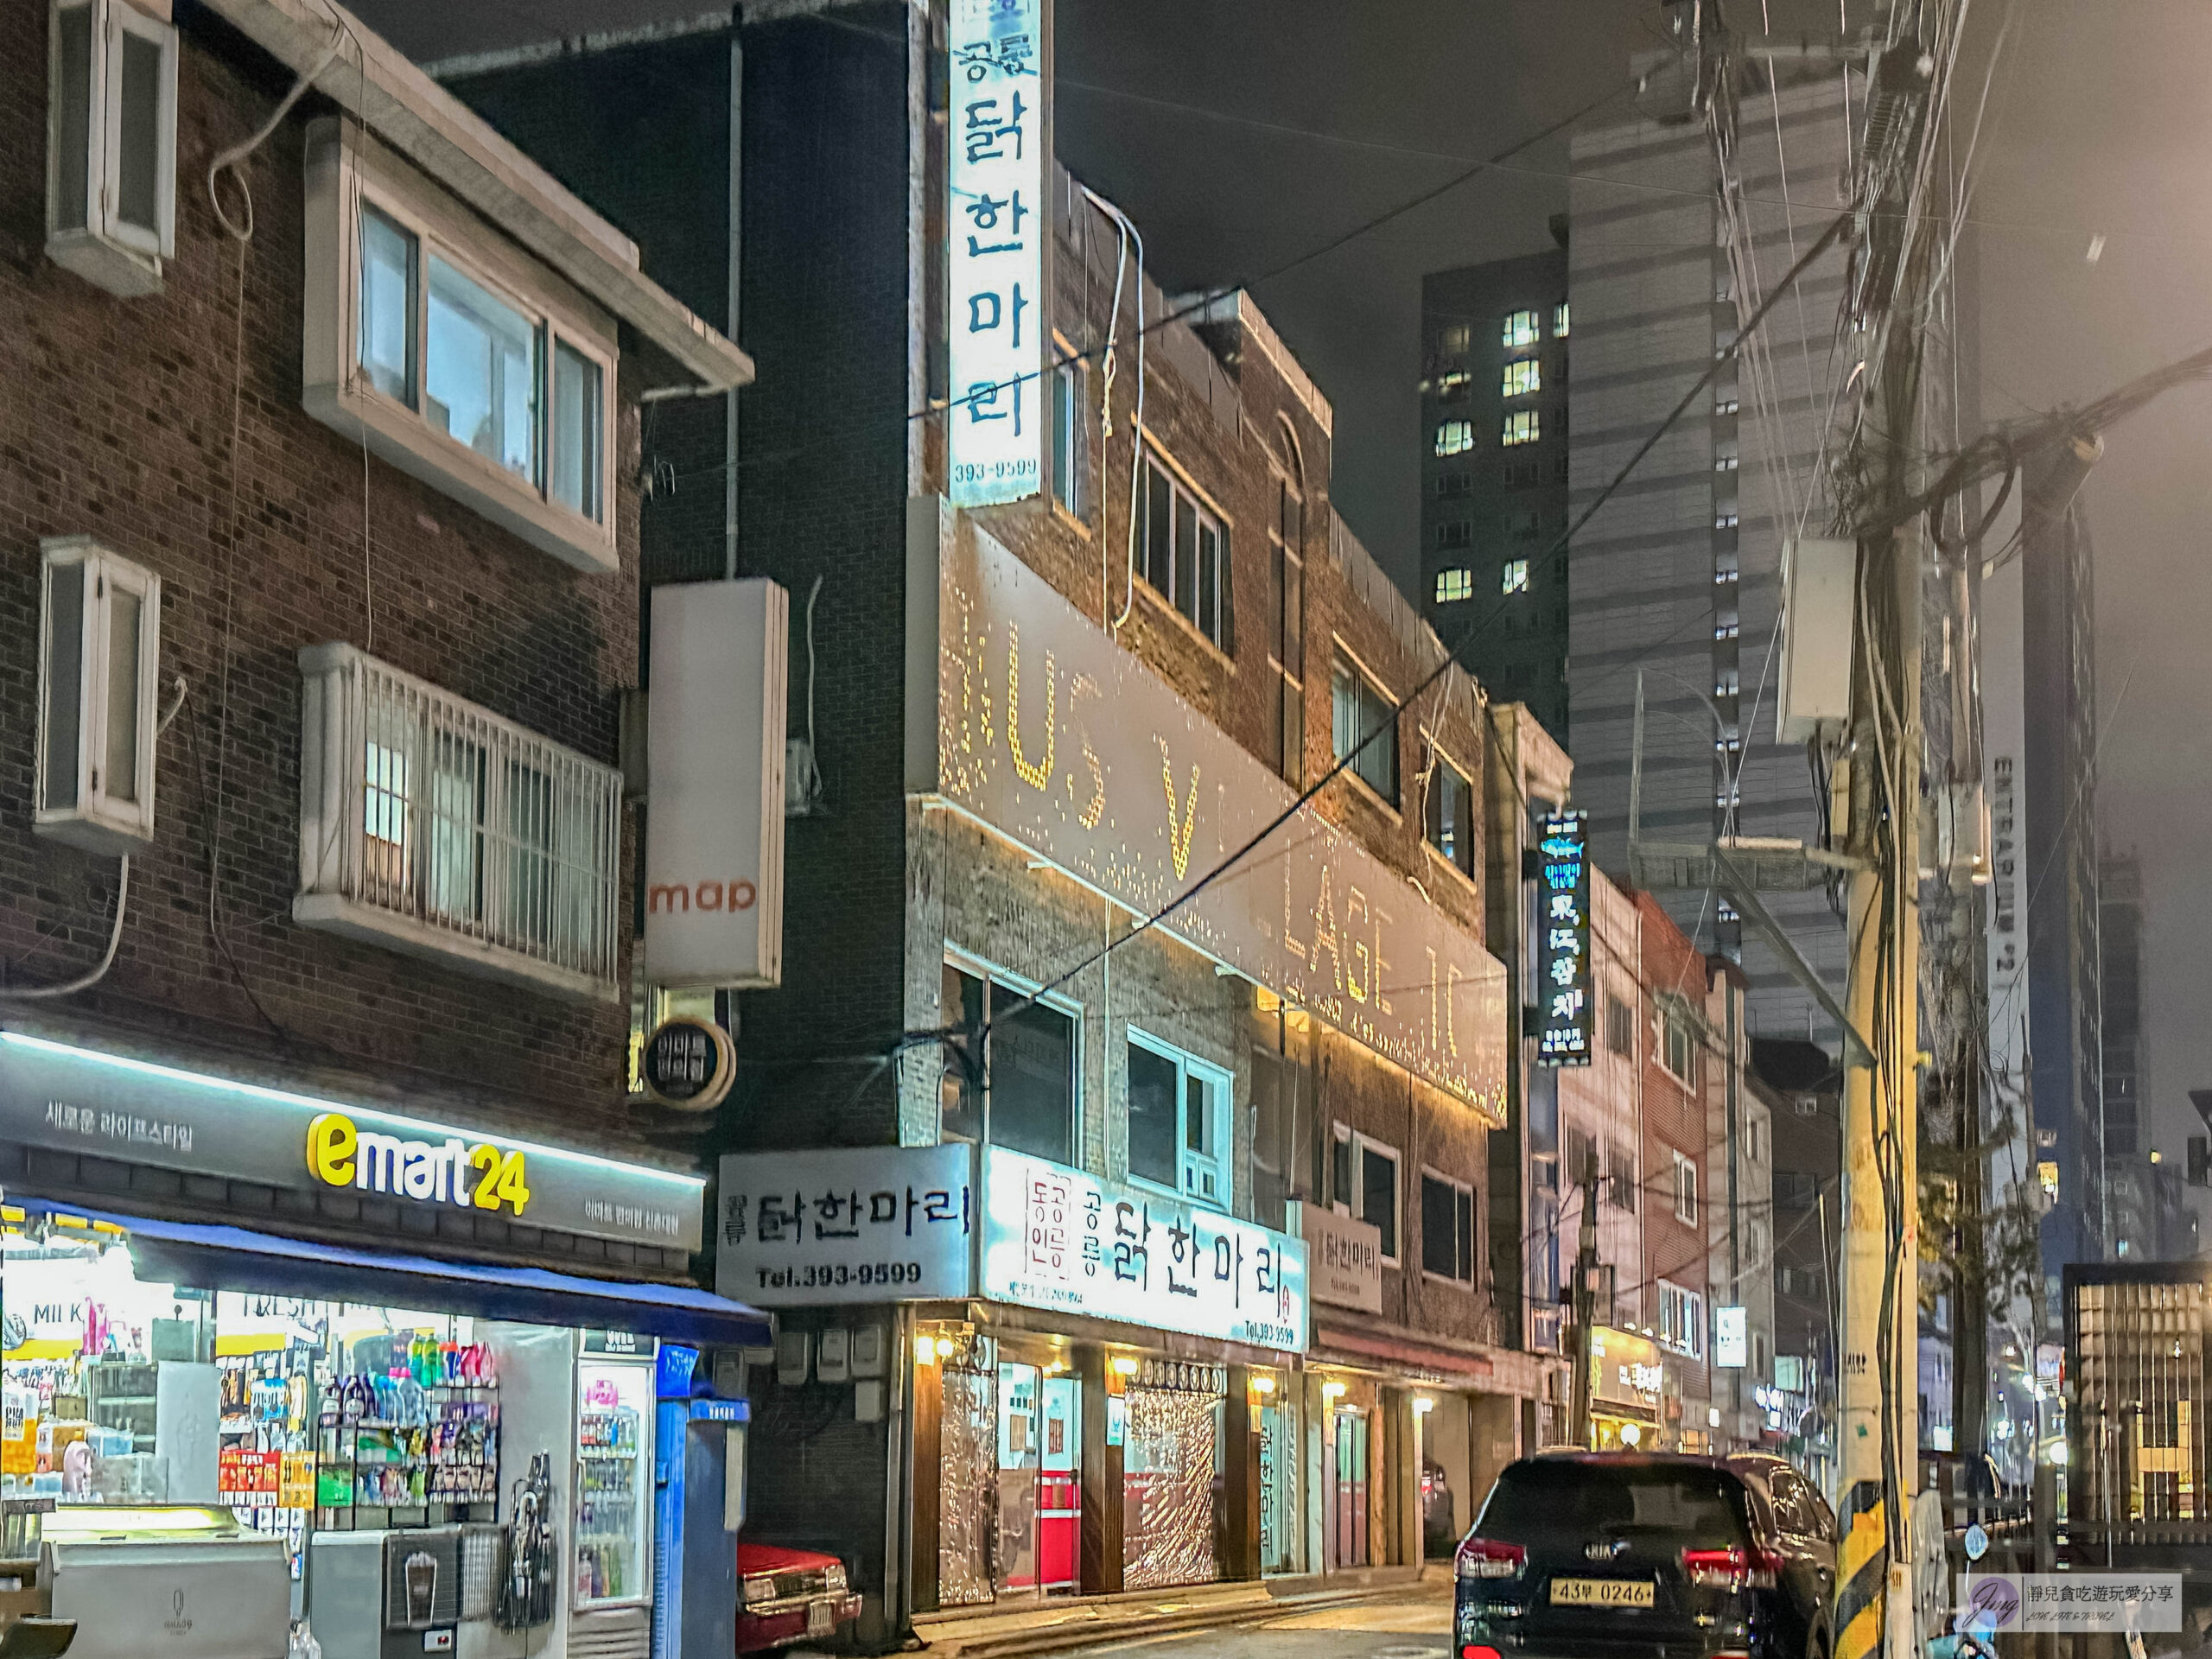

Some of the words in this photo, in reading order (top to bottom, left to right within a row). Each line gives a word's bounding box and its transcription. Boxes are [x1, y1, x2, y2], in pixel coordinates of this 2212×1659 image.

[965, 89, 1030, 438] 닭한마리
[649, 879, 756, 914] map
[306, 1113, 530, 1217] emart24
[1114, 1200, 1281, 1319] 닭한마리
[1600, 1583, 1644, 1602] 0246
